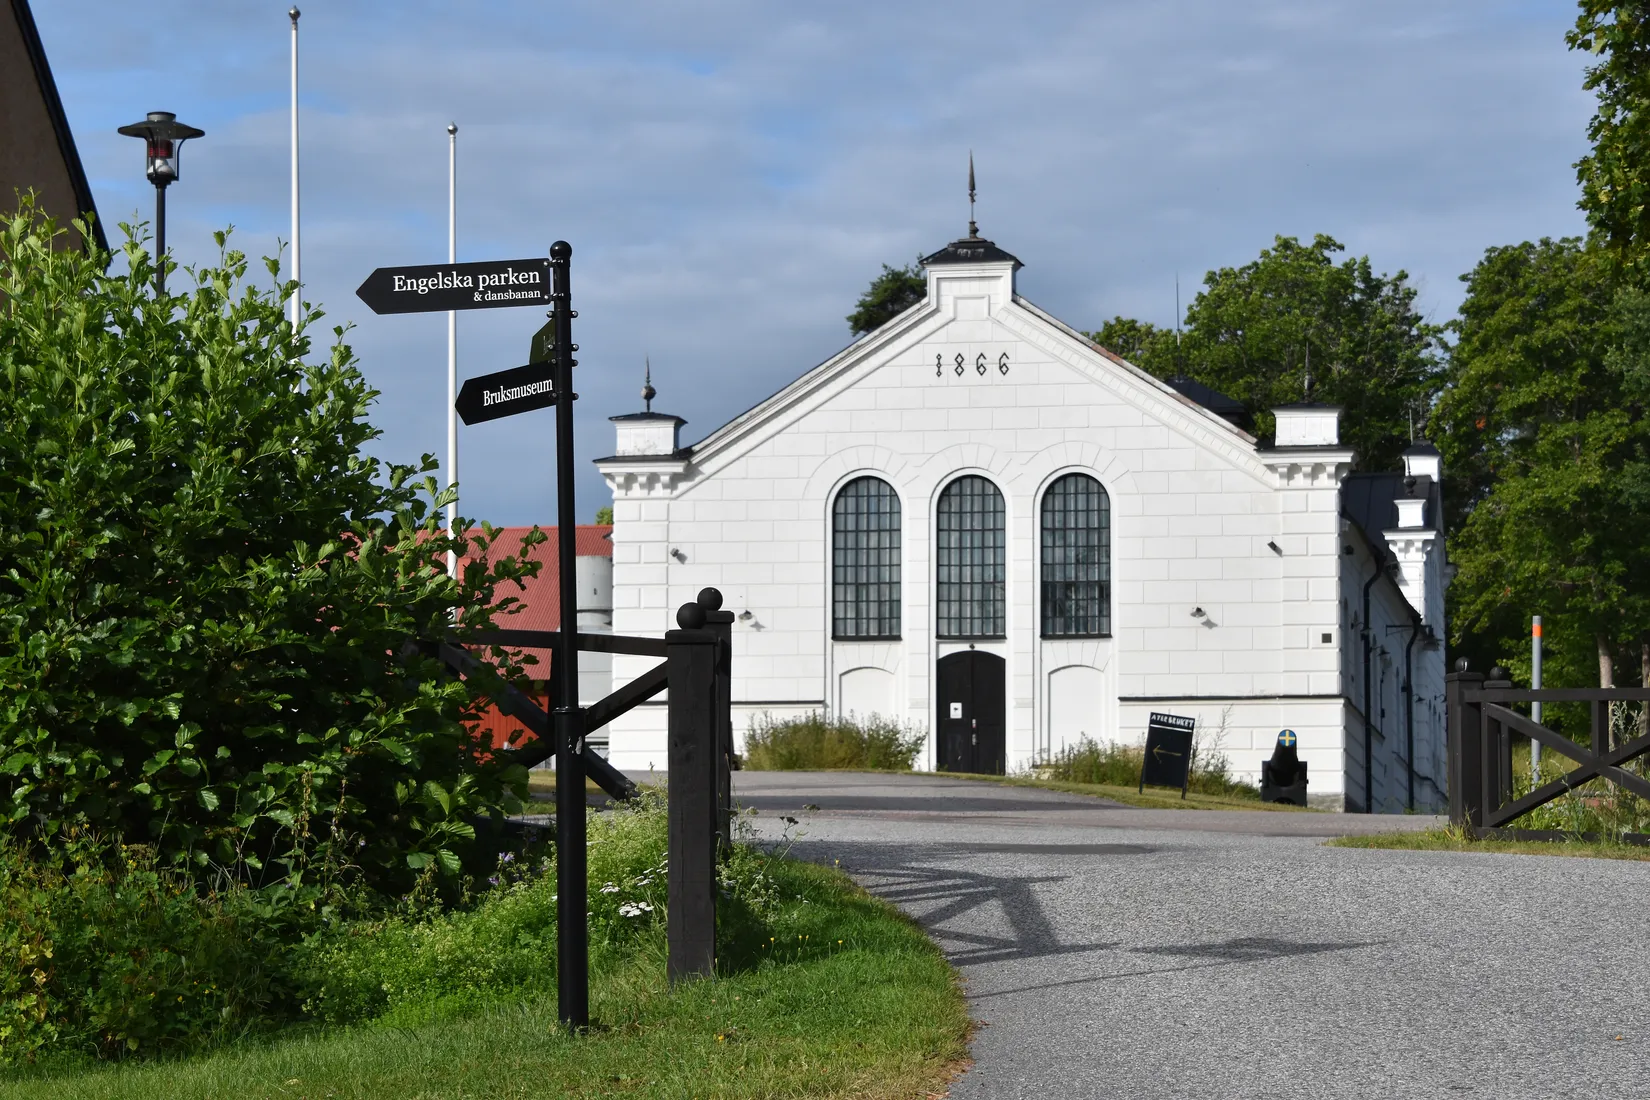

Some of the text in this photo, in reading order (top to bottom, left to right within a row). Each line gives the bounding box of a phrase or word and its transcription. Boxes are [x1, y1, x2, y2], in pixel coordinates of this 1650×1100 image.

[393, 268, 540, 294] Engelska parken
[473, 289, 541, 301] & dansbanan
[936, 352, 1009, 377] 1866
[483, 379, 553, 406] Bruksmuseum
